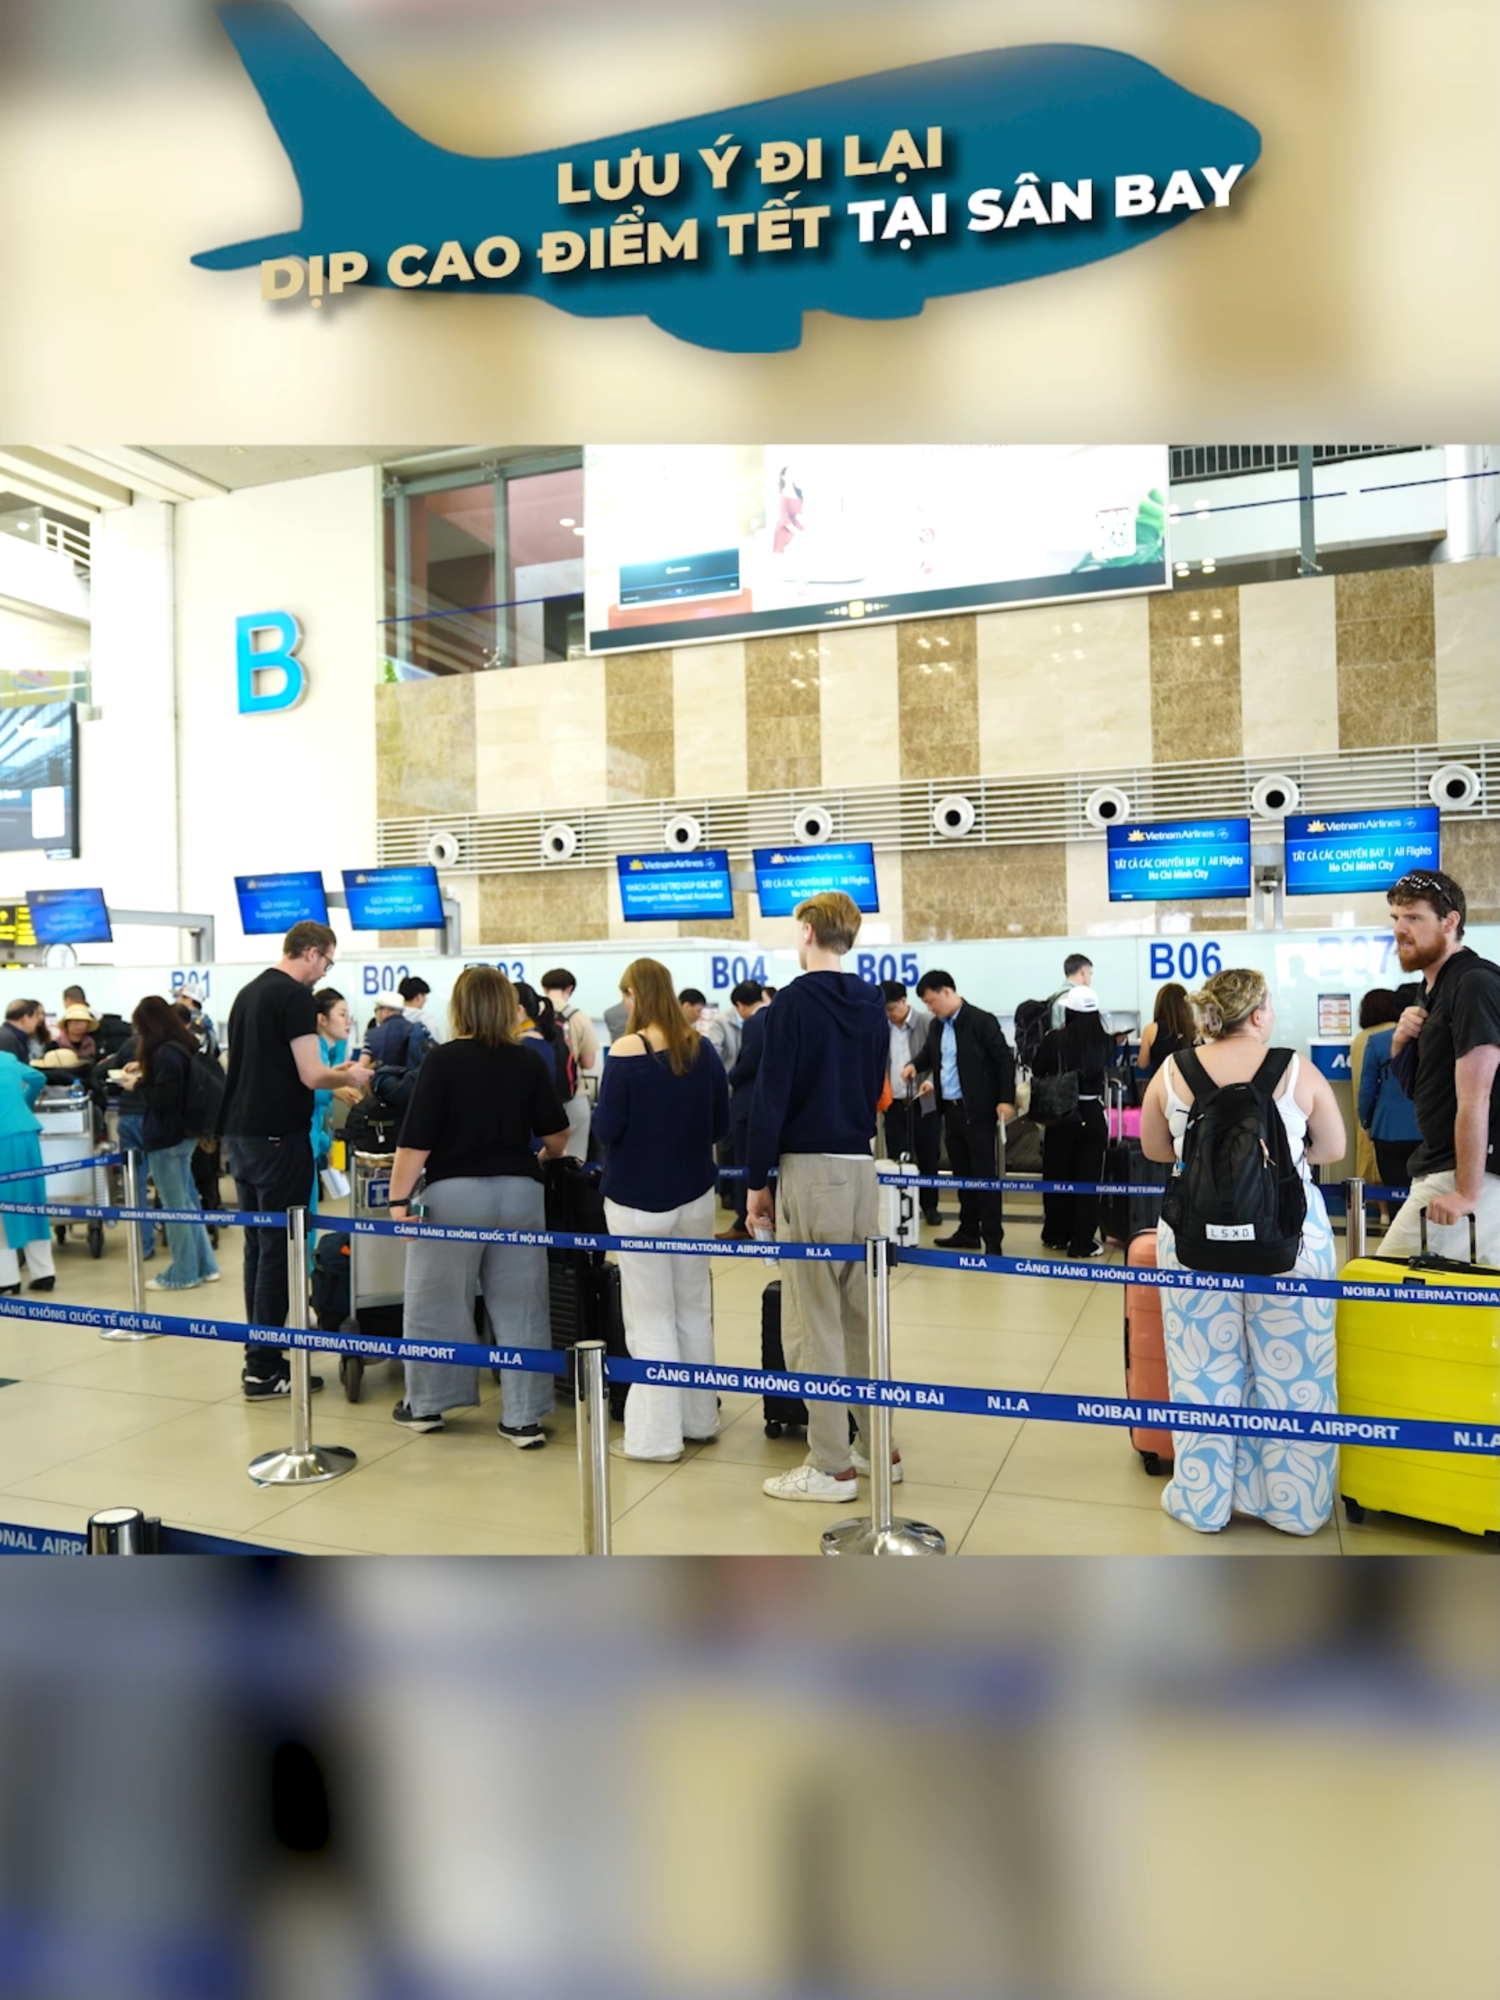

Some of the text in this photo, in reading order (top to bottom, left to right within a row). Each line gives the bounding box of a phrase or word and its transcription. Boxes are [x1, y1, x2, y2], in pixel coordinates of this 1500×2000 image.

[235, 610, 306, 715] B
[857, 953, 919, 987] B05
[1150, 941, 1222, 980] B06
[711, 955, 768, 989] B04
[145, 1211, 202, 1222] INTERNATIONAL
[203, 1213, 236, 1223] AIRPORT
[620, 1239, 780, 1256] NOIBAI INTERNATIONAL AIRPORT
[959, 1257, 987, 1268] N.I.A
[1015, 1259, 1244, 1290] CẢNG HÀNG KHÔNG QUỐC TẾ NỘI BÀI
[1276, 1281, 1308, 1293] N.I.A
[1342, 1285, 1500, 1303] NOIBAI INTERNATIONA
[69, 1309, 101, 1325] QUỐC
[103, 1311, 119, 1326] TẾ
[119, 1315, 140, 1331] NỘI
[189, 1322, 218, 1337] N.I.A
[248, 1328, 456, 1361] NOIBAI INTERNATIONAL AIRPORT
[489, 1350, 522, 1366] N.I.A
[645, 1364, 945, 1406] CẢNG HÀNG KHÔNG QUỐC TẾ NỘI BÀI
[987, 1395, 1030, 1412] N.I.A
[1077, 1402, 1400, 1441] NOIBAI INTERNATIONAL AIRPORT
